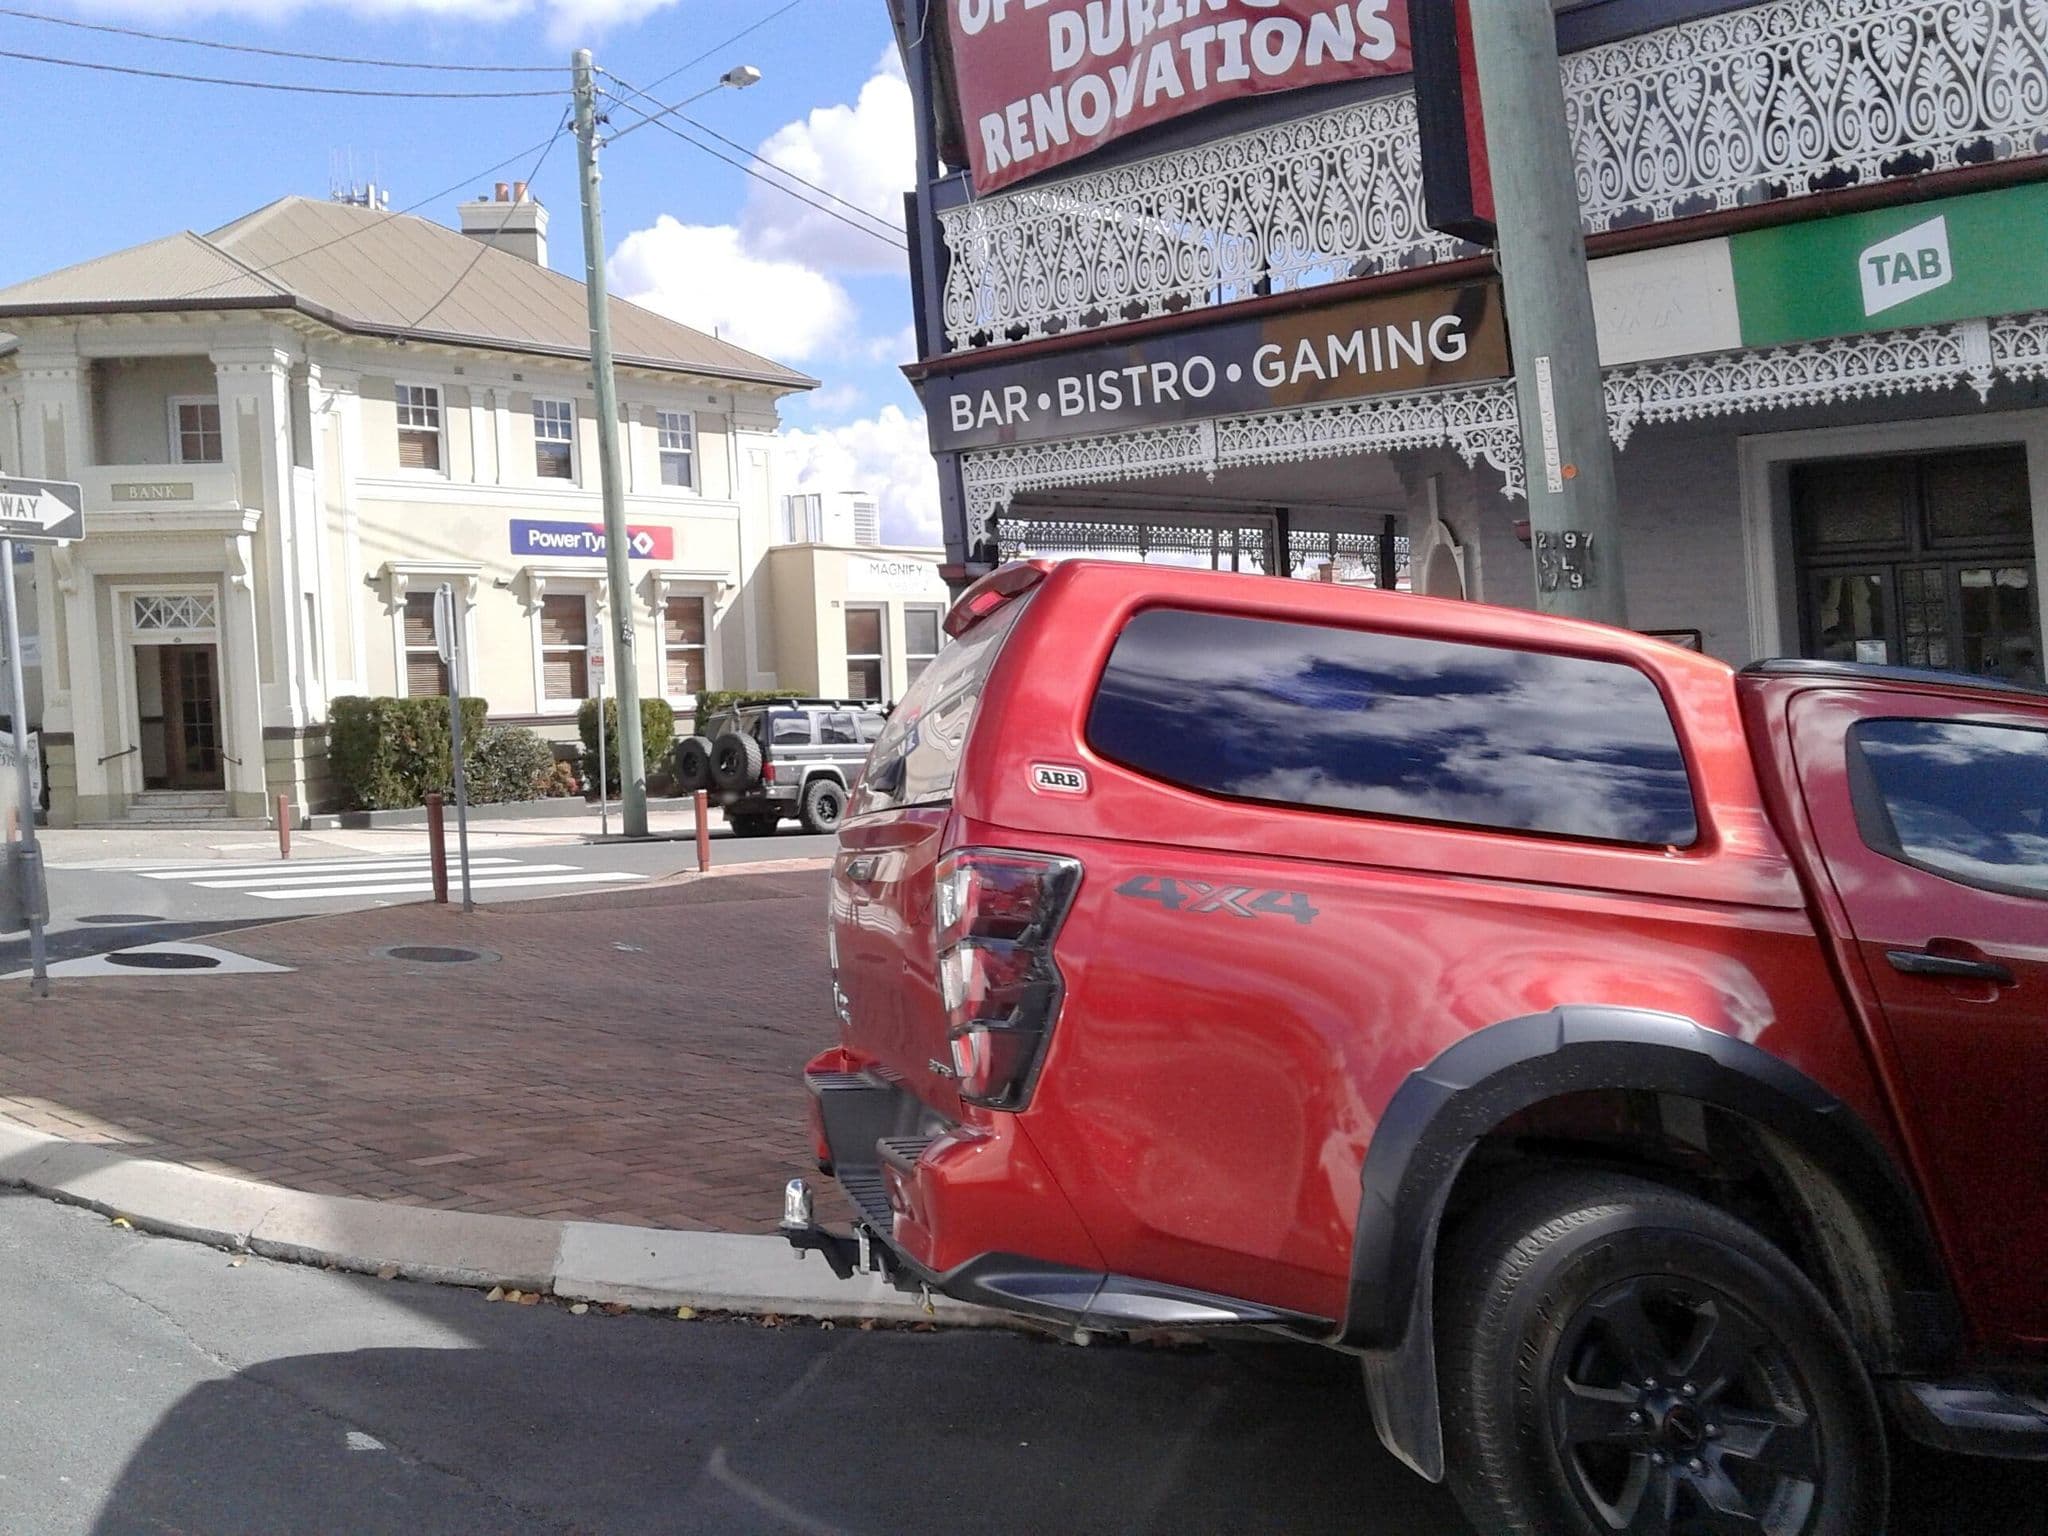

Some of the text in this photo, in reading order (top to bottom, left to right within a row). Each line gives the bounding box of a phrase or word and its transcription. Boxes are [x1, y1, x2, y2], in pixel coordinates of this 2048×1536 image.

[979, 0, 1396, 174] RENOVATIONS
[1868, 247, 1943, 287] TAB
[950, 315, 1468, 432] BAR BISTRO GAMING
[129, 485, 176, 499] BANK
[0, 495, 38, 519] WAY
[869, 562, 923, 577] MAGNIFY
[1039, 770, 1080, 788] ARB
